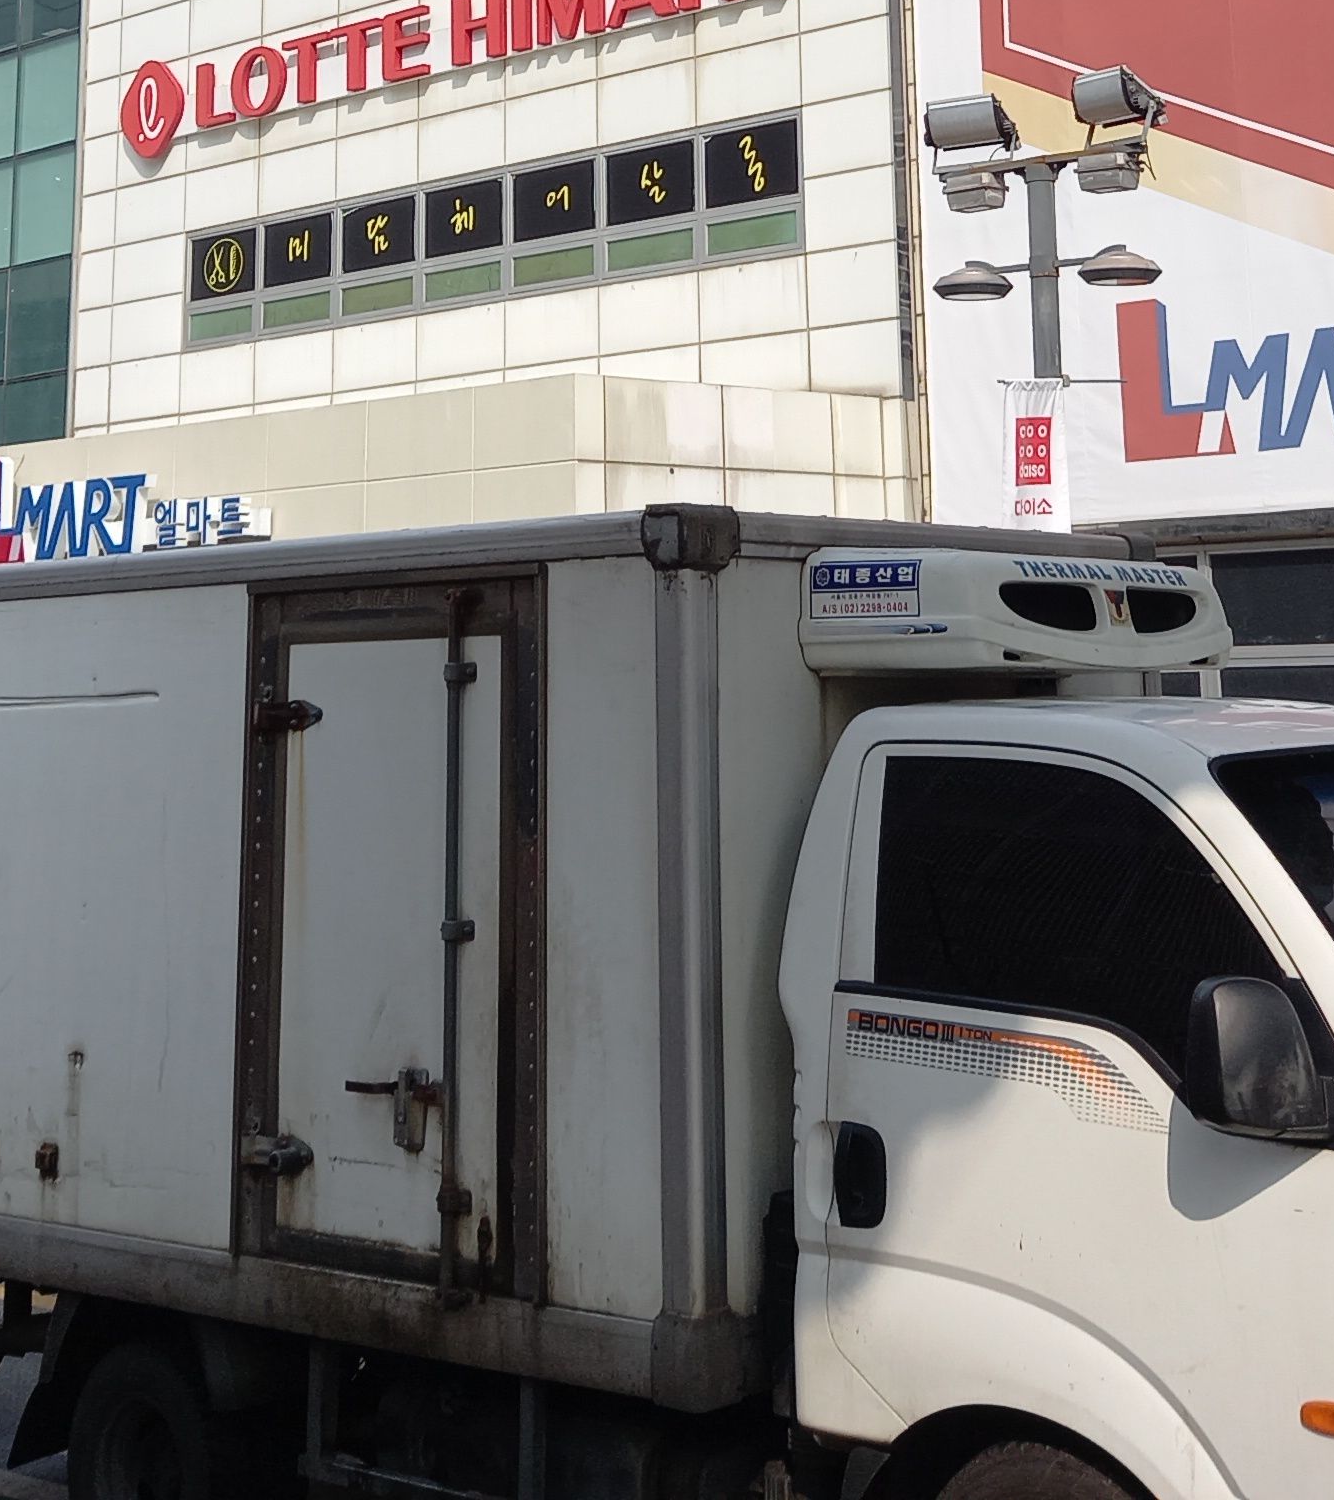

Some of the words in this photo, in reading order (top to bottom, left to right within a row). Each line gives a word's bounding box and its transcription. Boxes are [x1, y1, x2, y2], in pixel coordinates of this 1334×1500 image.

[195, 4, 431, 128] LOTTE
[1018, 461, 1046, 479] daiso
[1014, 497, 1054, 517] 다이소
[153, 496, 245, 547] 엘마트
[1012, 560, 1113, 581] THERMAL
[1113, 565, 1188, 587] MASTER
[822, 604, 838, 614] A/S
[857, 1010, 939, 1040] BONGO
[966, 1028, 993, 1042] TON
